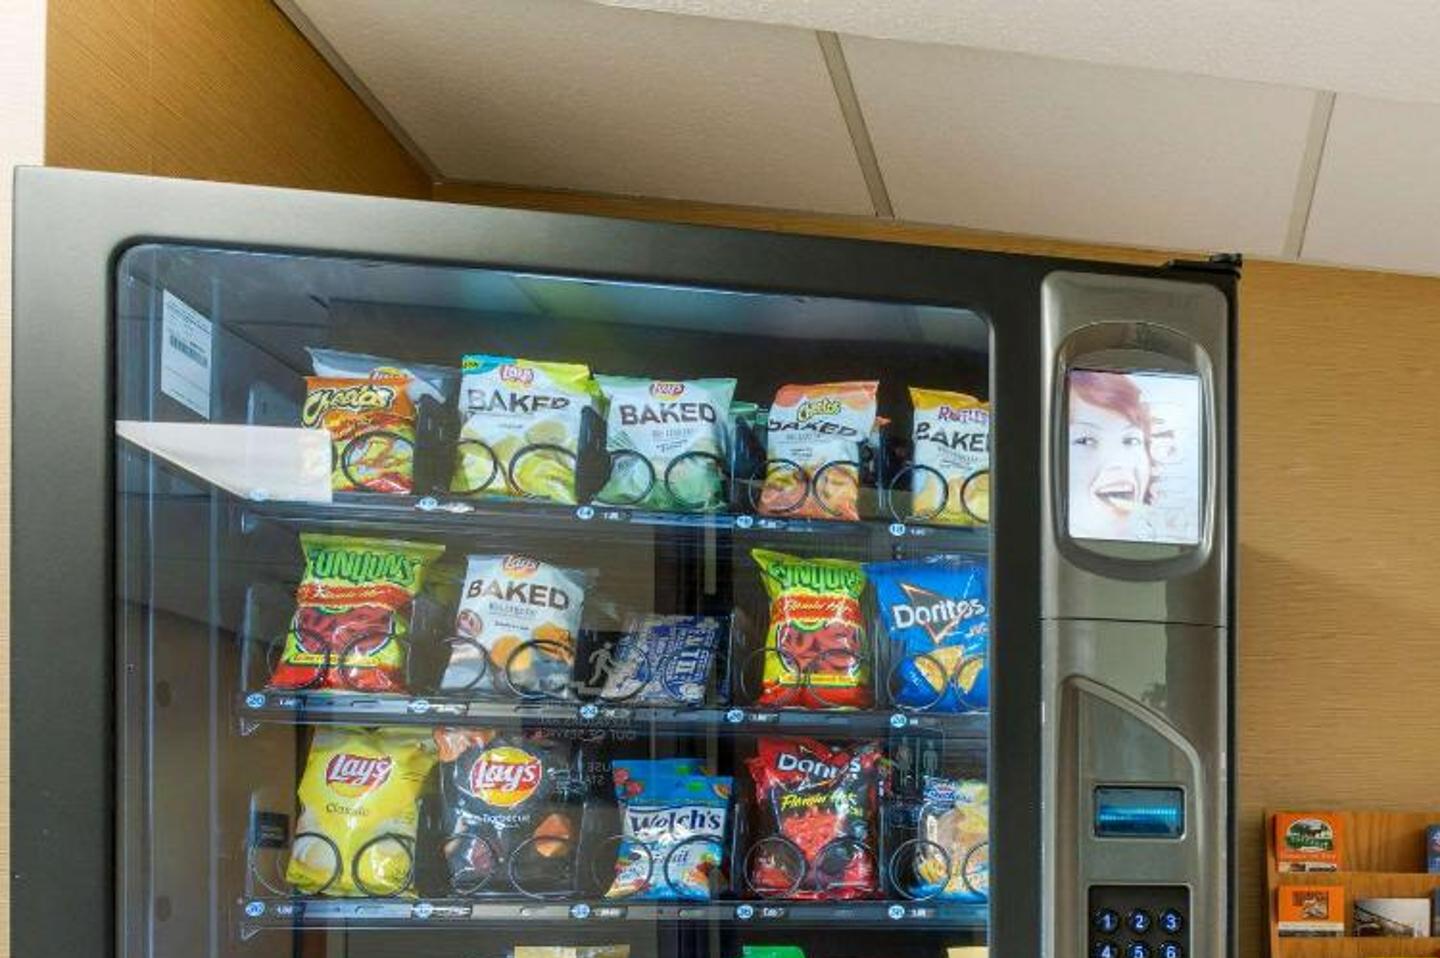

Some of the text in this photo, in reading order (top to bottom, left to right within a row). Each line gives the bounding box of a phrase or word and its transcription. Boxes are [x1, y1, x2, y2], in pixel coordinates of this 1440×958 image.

[467, 388, 570, 413] BAKED
[619, 403, 716, 426] BAKED
[915, 422, 990, 453] BAKE
[466, 579, 570, 611] BAKED
[892, 596, 986, 629] Doritos
[327, 754, 393, 789] Lay's
[473, 760, 540, 793] Lay's
[778, 751, 861, 780] Doris
[631, 807, 722, 832] Welch's
[1103, 915, 1176, 928] 1 2 3
[1102, 946, 1110, 958] 4
